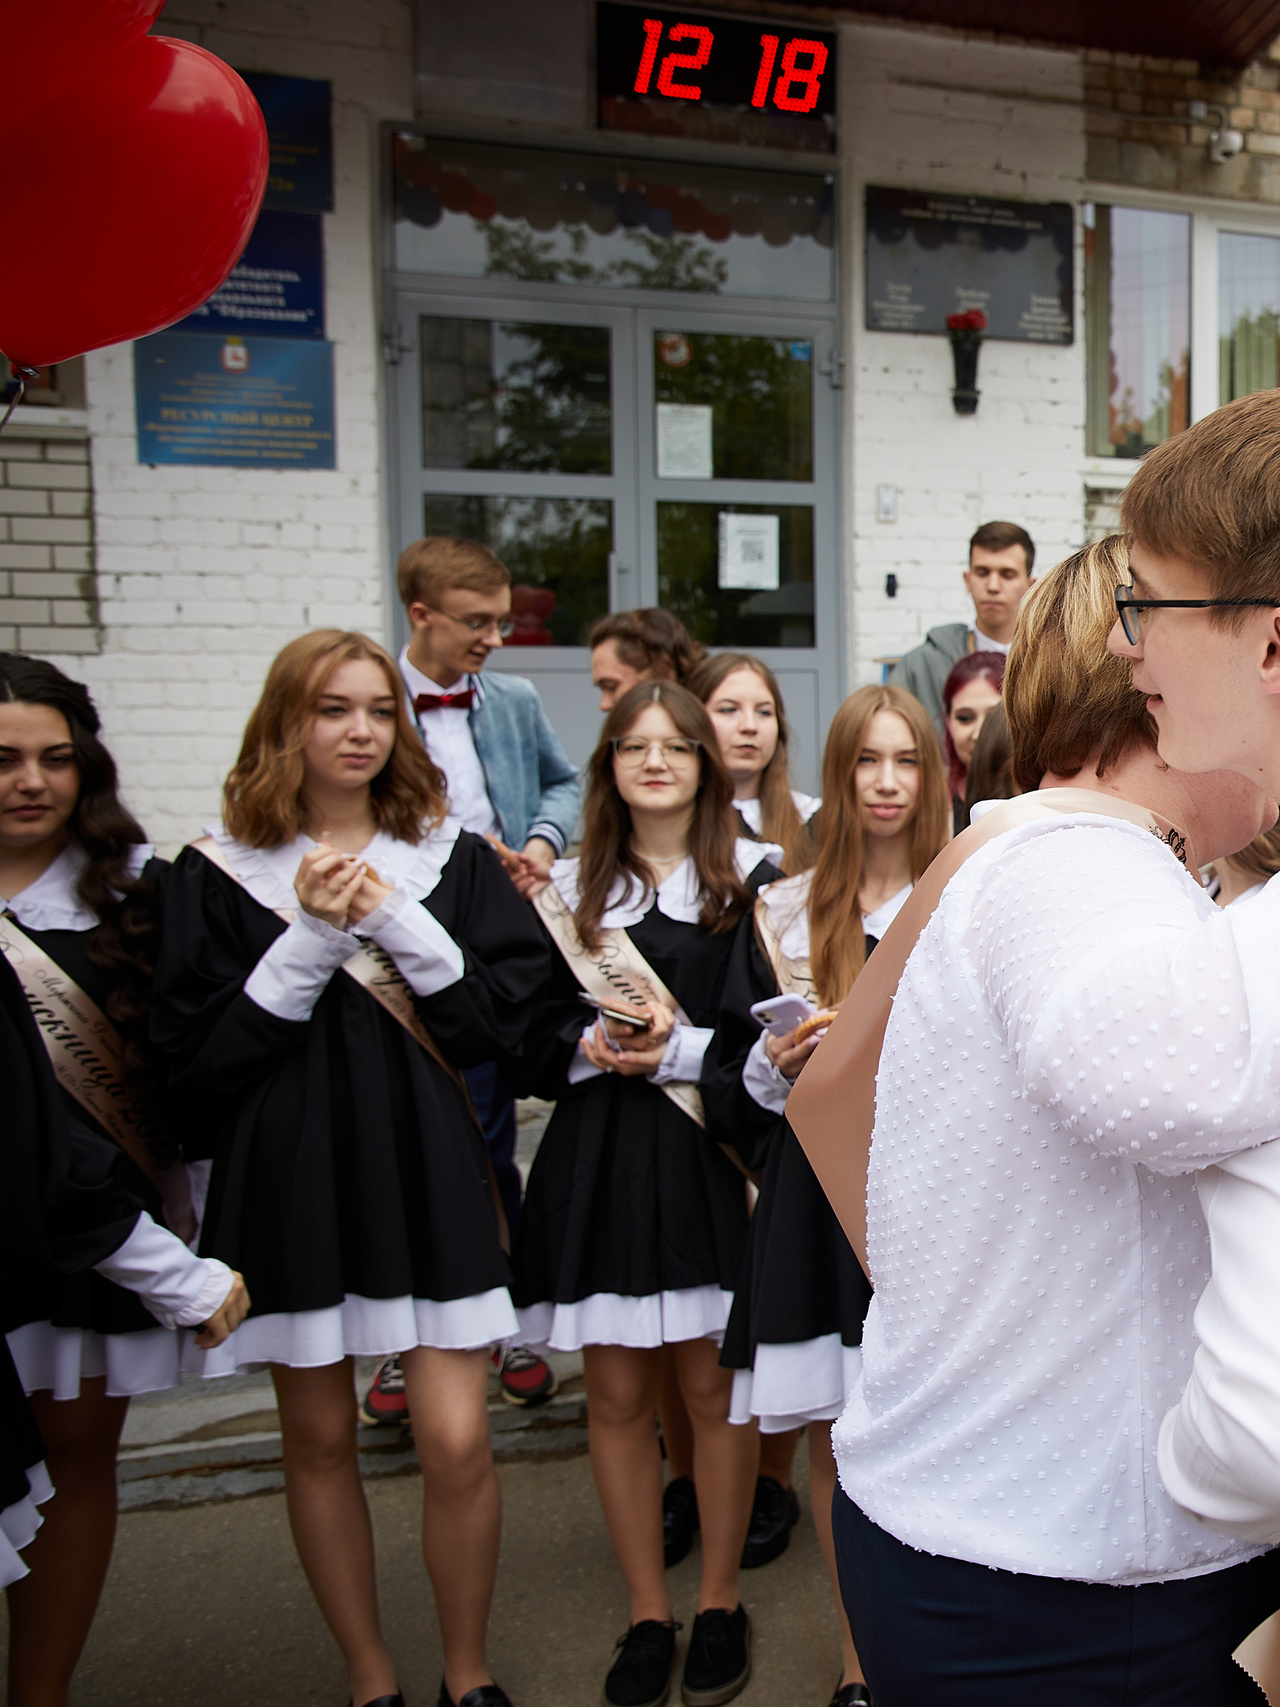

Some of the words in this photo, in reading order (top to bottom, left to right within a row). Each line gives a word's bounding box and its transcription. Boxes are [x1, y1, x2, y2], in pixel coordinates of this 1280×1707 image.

[634, 19, 714, 100] 12
[751, 34, 829, 113] 18
[160, 406, 259, 427] РЕСУРСНЫЙ
[261, 411, 314, 429] ЦЕНТР
